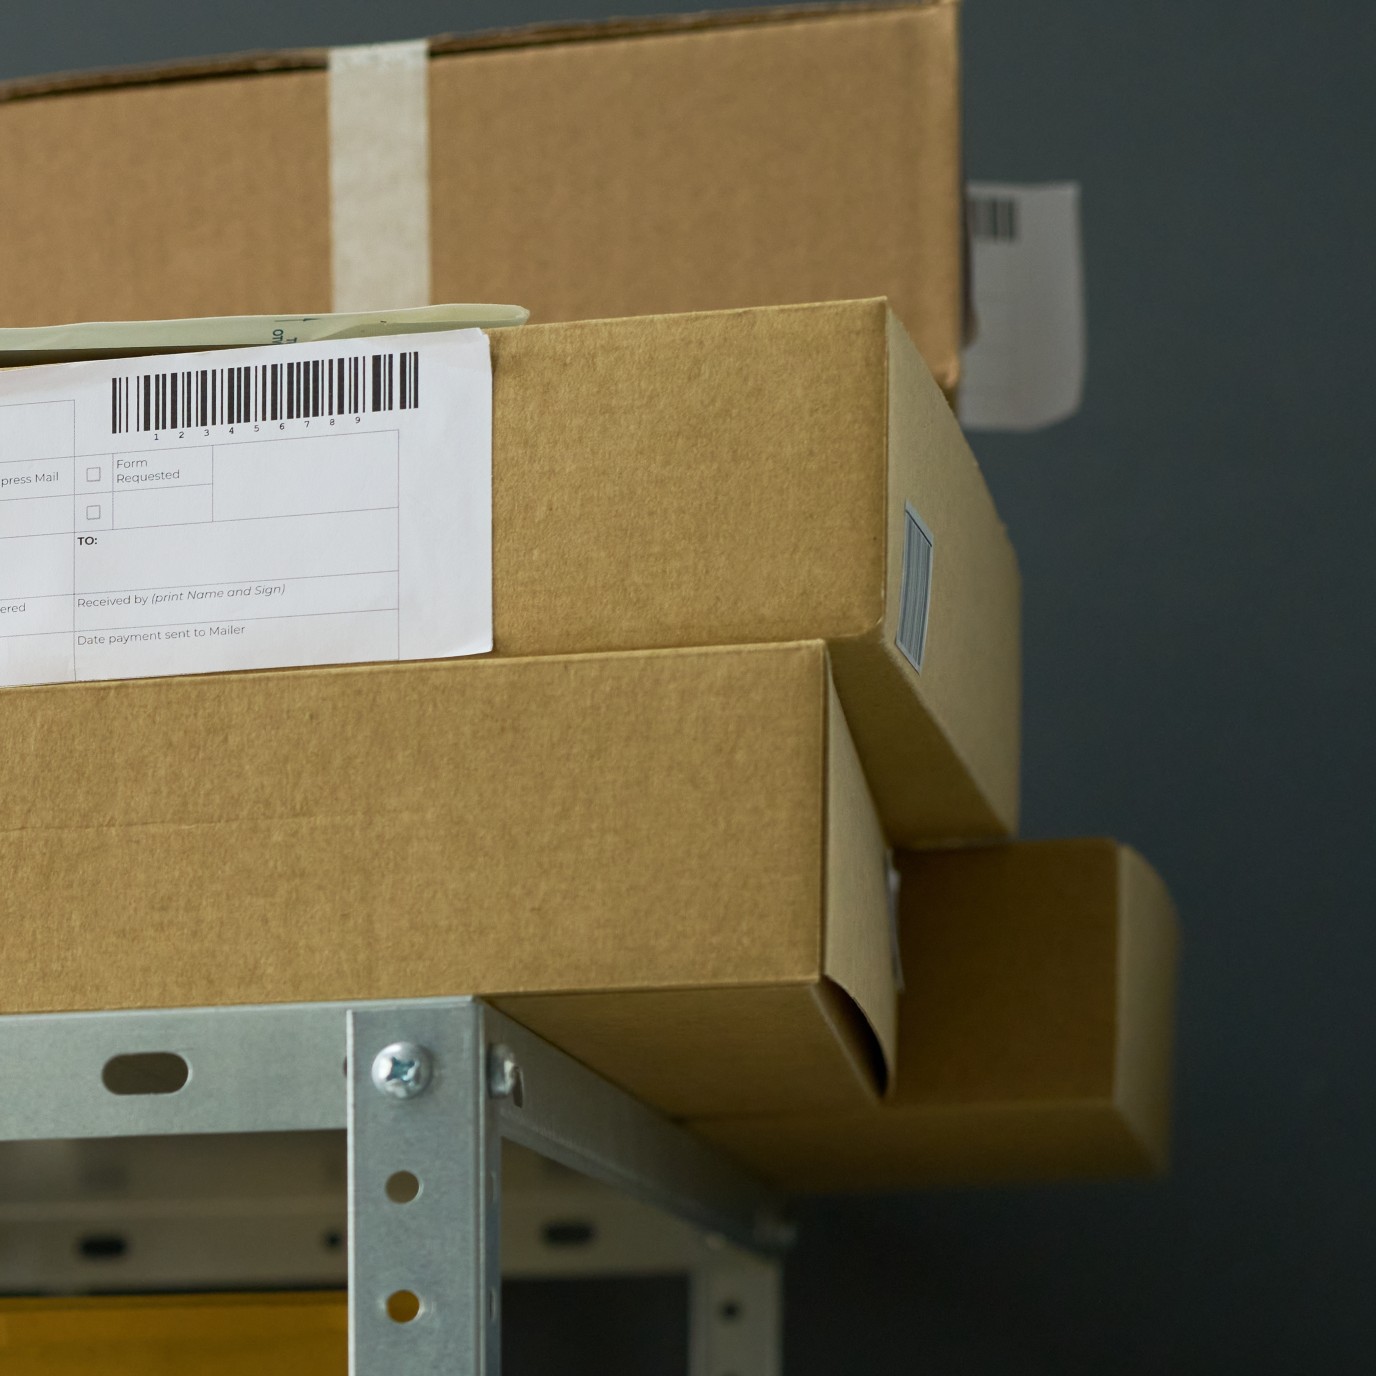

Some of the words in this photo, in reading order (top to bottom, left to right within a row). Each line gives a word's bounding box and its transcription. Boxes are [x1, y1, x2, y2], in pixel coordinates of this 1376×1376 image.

[116, 458, 148, 469] Form
[35, 472, 59, 483] Mail
[116, 470, 180, 484] Requested
[77, 536, 98, 545] TO:
[77, 595, 131, 607] Received
[134, 594, 148, 605] by
[151, 591, 184, 605] (print
[187, 589, 225, 600] Name
[227, 587, 252, 597] and
[254, 583, 286, 597] Sign)
[77, 635, 105, 646] Date
[108, 631, 162, 646] payment
[165, 627, 191, 639] sent
[194, 628, 206, 637] to
[209, 624, 245, 637] Mailer
